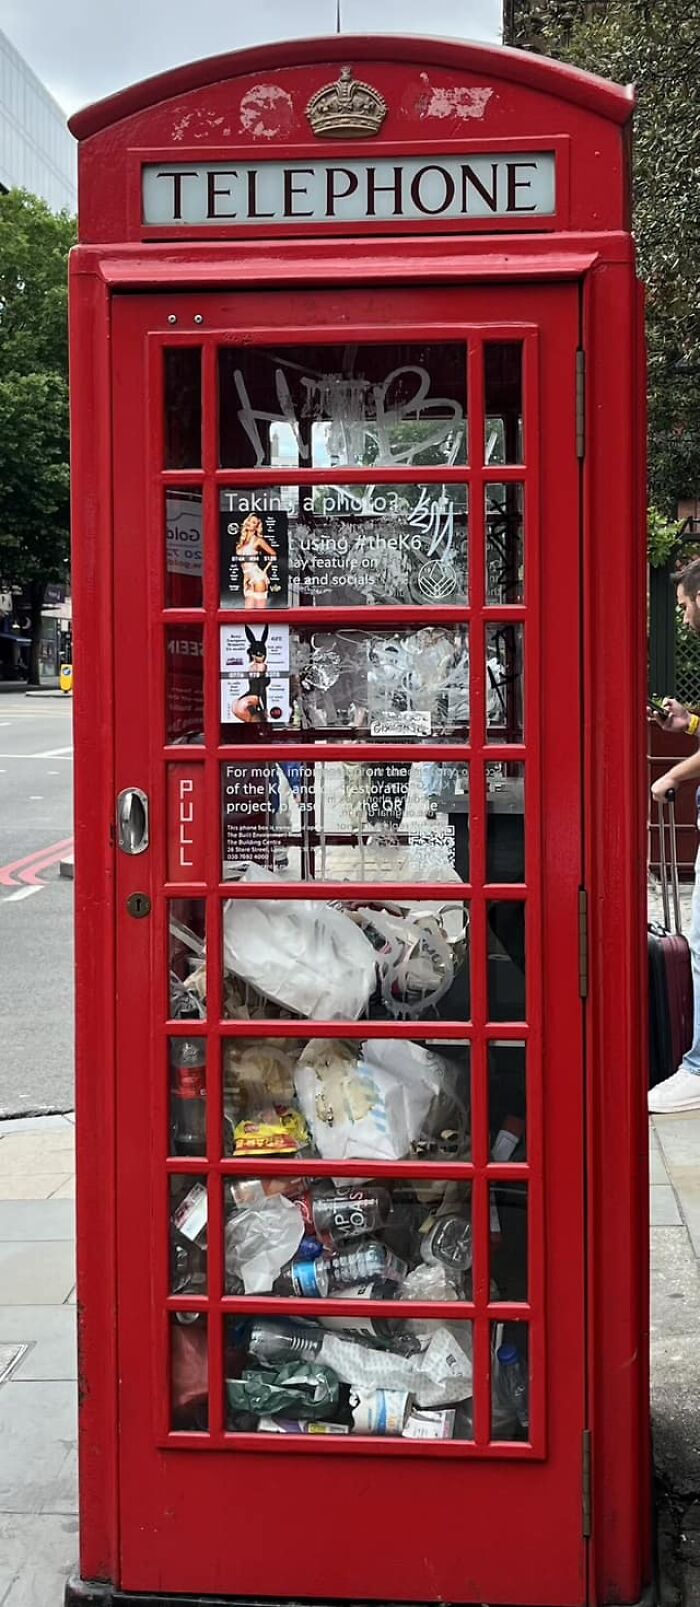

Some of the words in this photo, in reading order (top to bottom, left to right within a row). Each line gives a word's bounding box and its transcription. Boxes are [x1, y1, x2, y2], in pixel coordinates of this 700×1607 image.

[157, 163, 537, 219] TELEPHONE
[303, 499, 313, 511] a
[323, 491, 399, 515] phoo?
[301, 534, 348, 554] using
[355, 533, 421, 550] #theK6
[311, 557, 358, 568] feature
[361, 559, 379, 568] on
[304, 573, 328, 585] and
[332, 573, 375, 585] socials
[226, 766, 247, 778] For
[385, 765, 407, 777] the
[226, 783, 240, 795] of
[243, 783, 265, 795] the
[268, 783, 284, 794] K
[347, 782, 416, 794] restoratio
[226, 800, 276, 815] project,
[382, 800, 404, 813] QR
[180, 779, 193, 866] PULL
